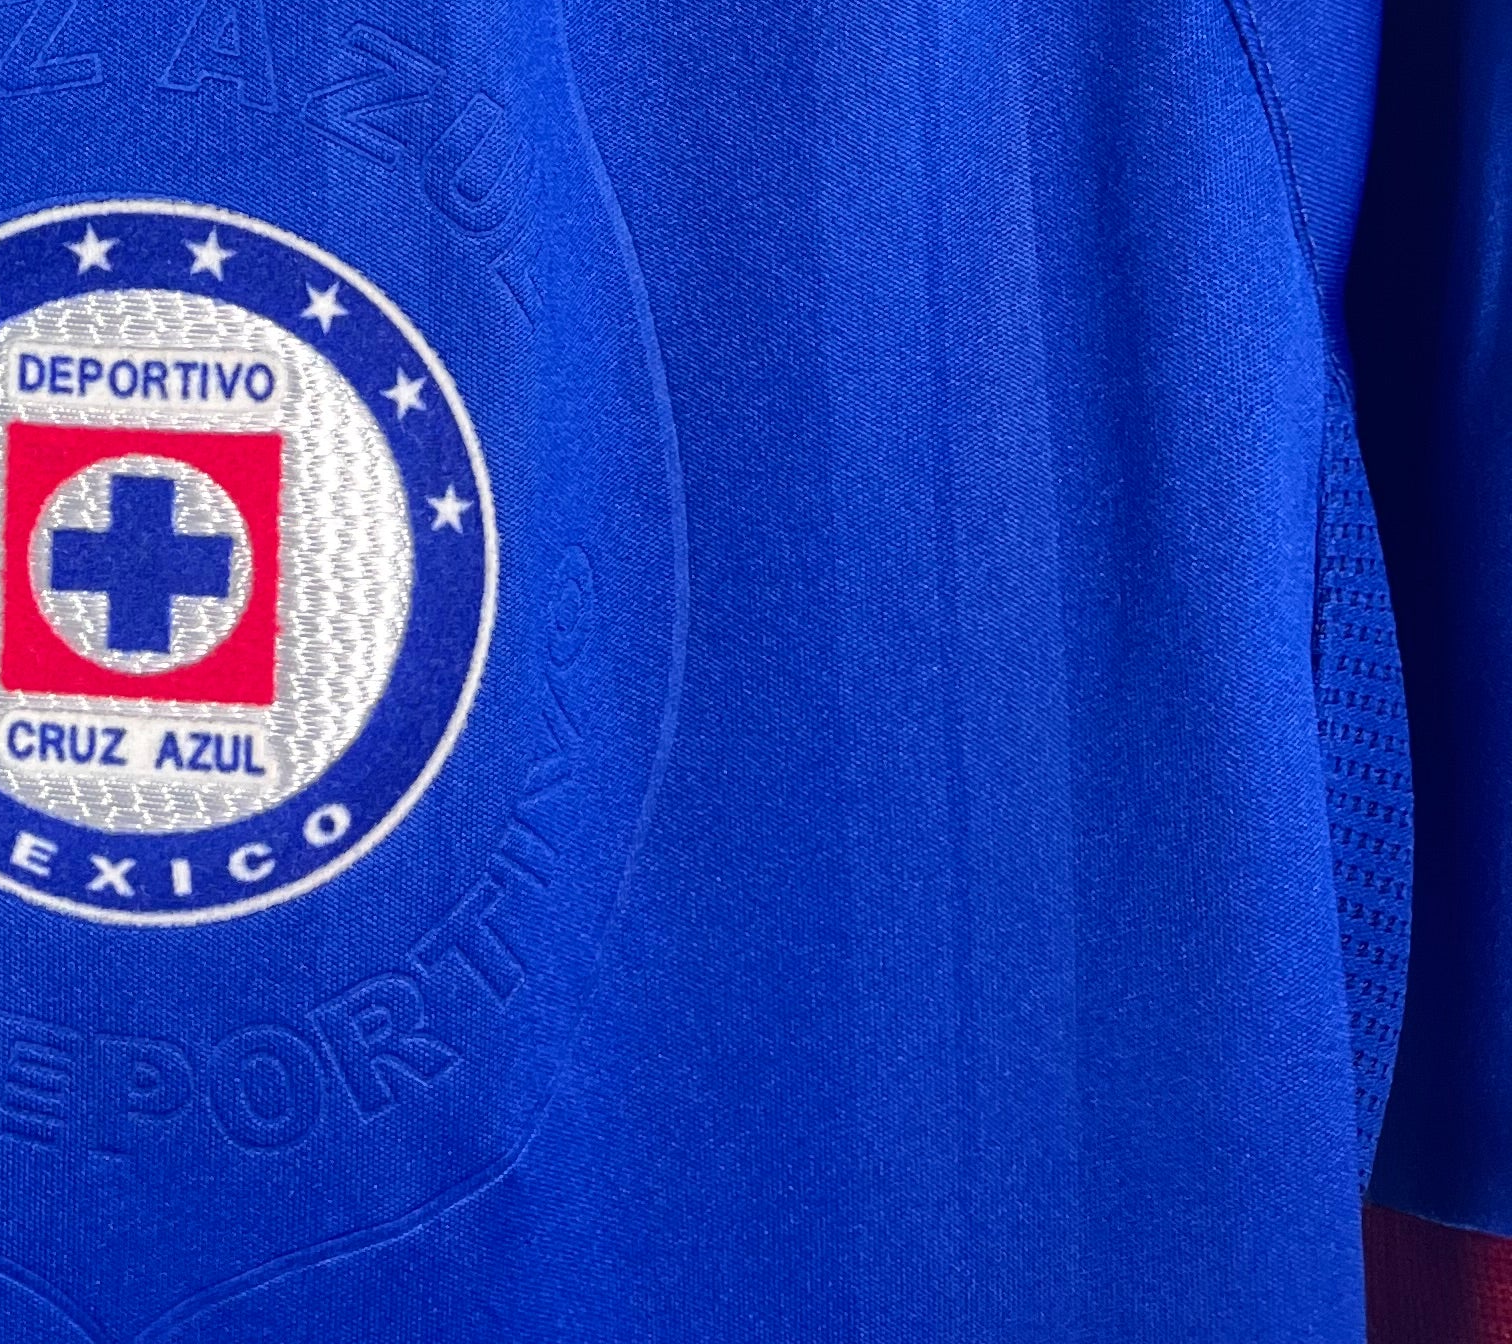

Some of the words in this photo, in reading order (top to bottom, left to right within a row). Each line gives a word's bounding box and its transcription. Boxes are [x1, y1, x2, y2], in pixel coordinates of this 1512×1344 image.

[16, 352, 278, 404] DEPORTIVO
[5, 719, 125, 768] CRUZ
[154, 729, 267, 776] AZUL
